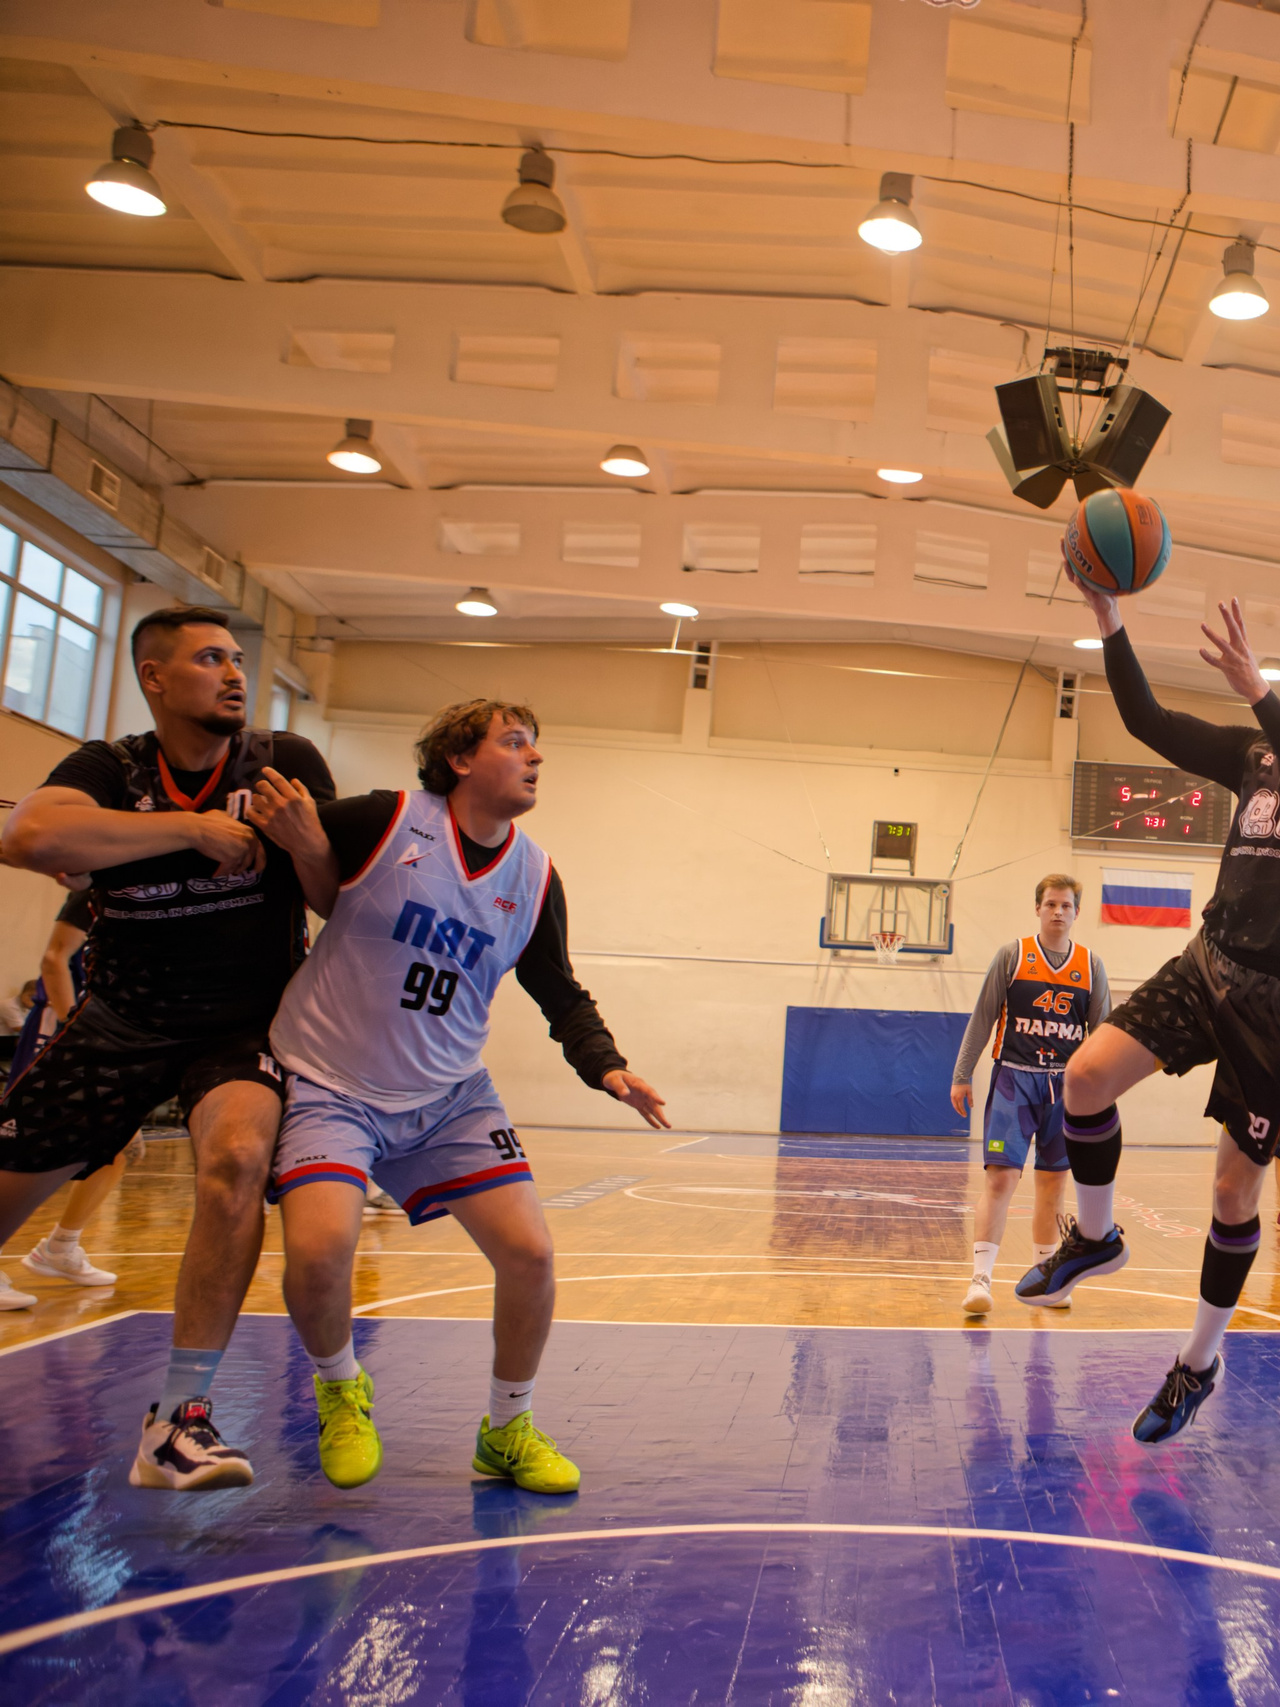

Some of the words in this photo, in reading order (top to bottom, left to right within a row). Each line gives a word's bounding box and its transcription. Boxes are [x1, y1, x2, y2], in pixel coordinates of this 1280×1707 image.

[1192, 791, 1202, 806] 2
[888, 825, 911, 836] 7:31
[1145, 817, 1166, 828] 7:31
[409, 826, 436, 842] MAXX
[400, 961, 459, 1016] 99
[1032, 989, 1075, 1015] 46
[1015, 1017, 1083, 1041] ПАРМА
